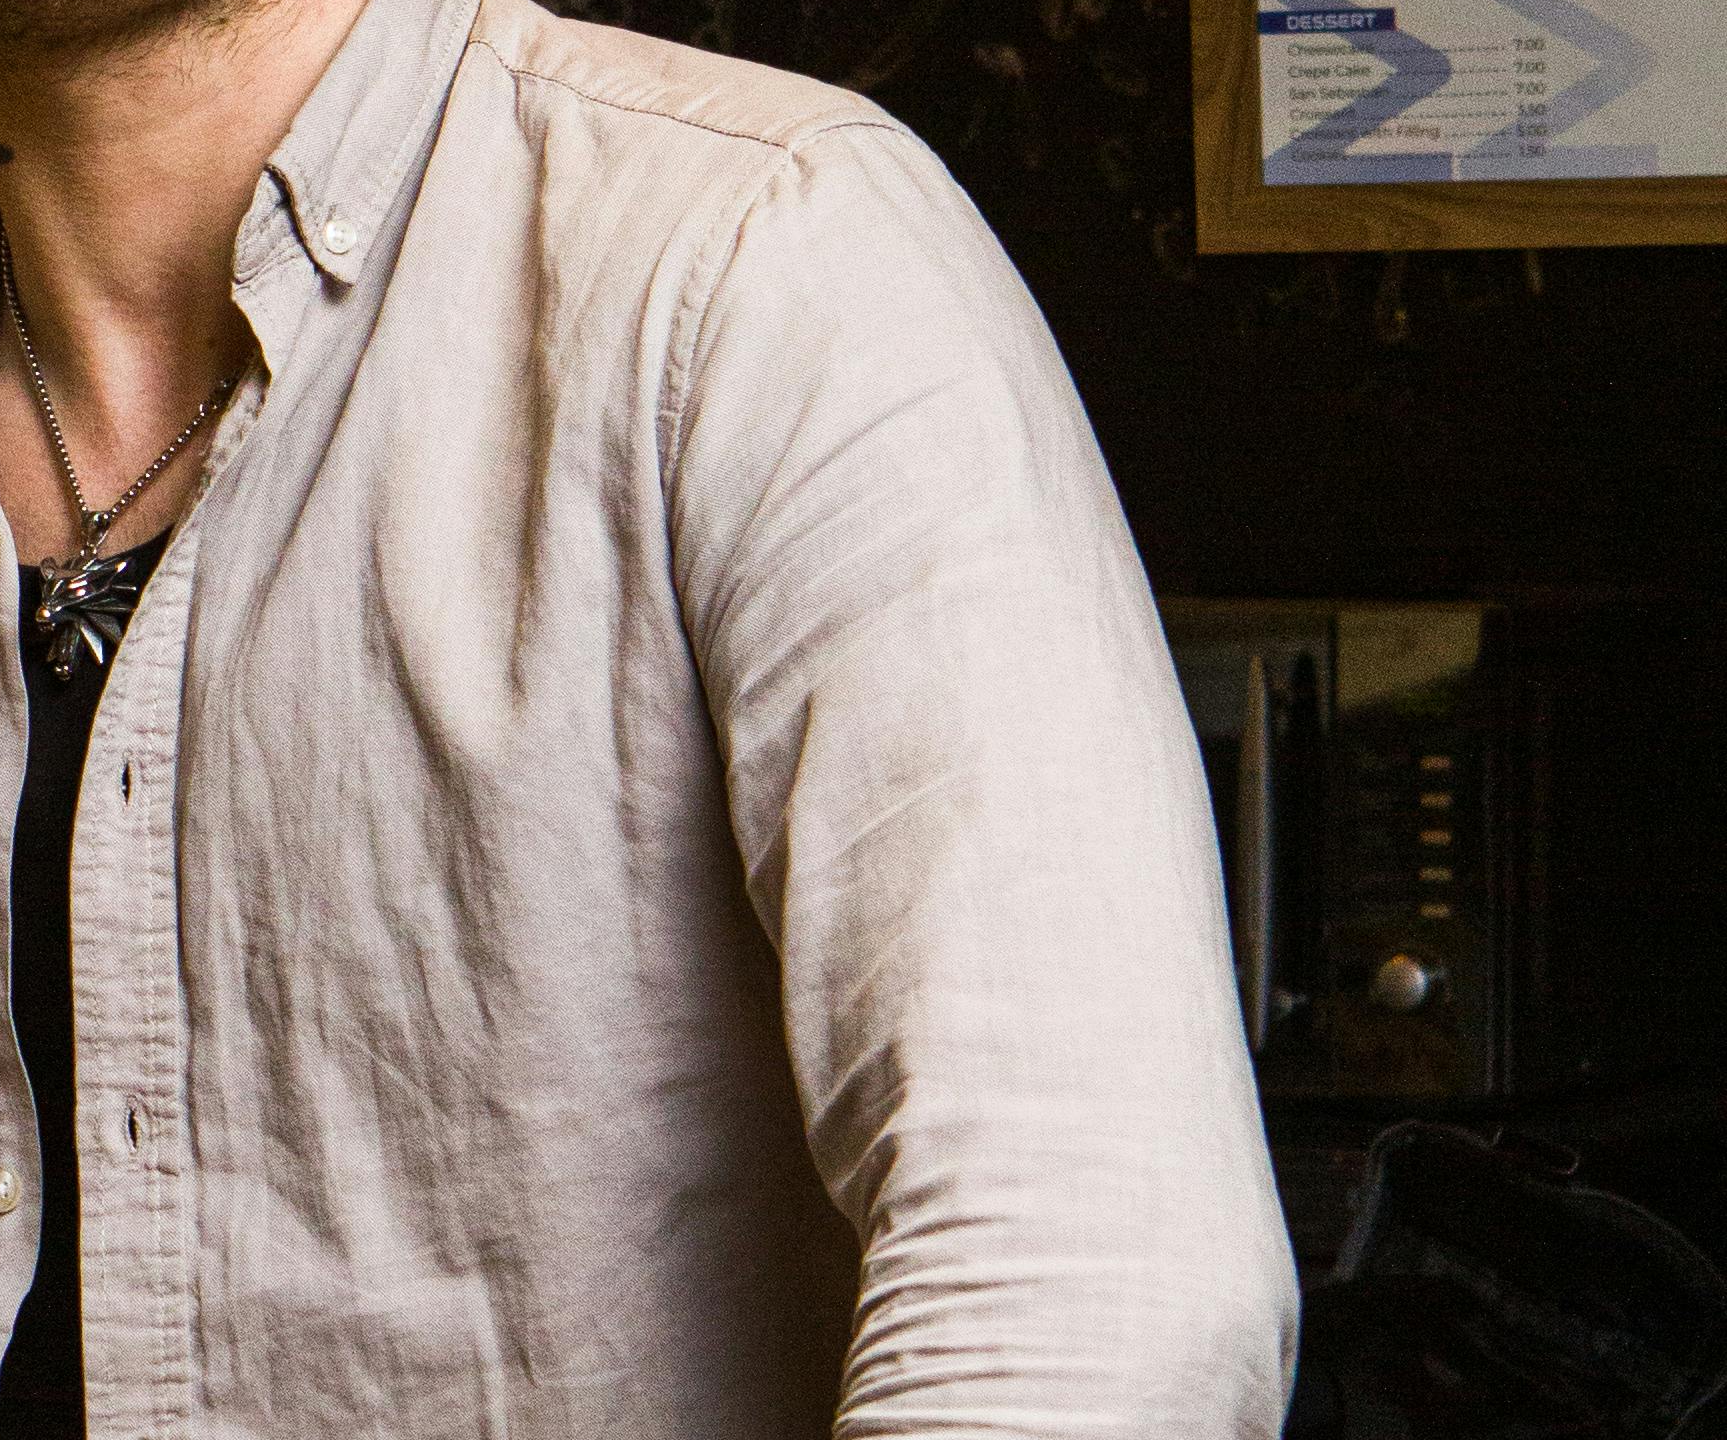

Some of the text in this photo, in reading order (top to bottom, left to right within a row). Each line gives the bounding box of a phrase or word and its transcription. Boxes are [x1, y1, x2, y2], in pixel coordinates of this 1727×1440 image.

[1285, 13, 1377, 32] DESSERT
[1288, 63, 1330, 81] Crepe
[1334, 63, 1371, 78] Cake
